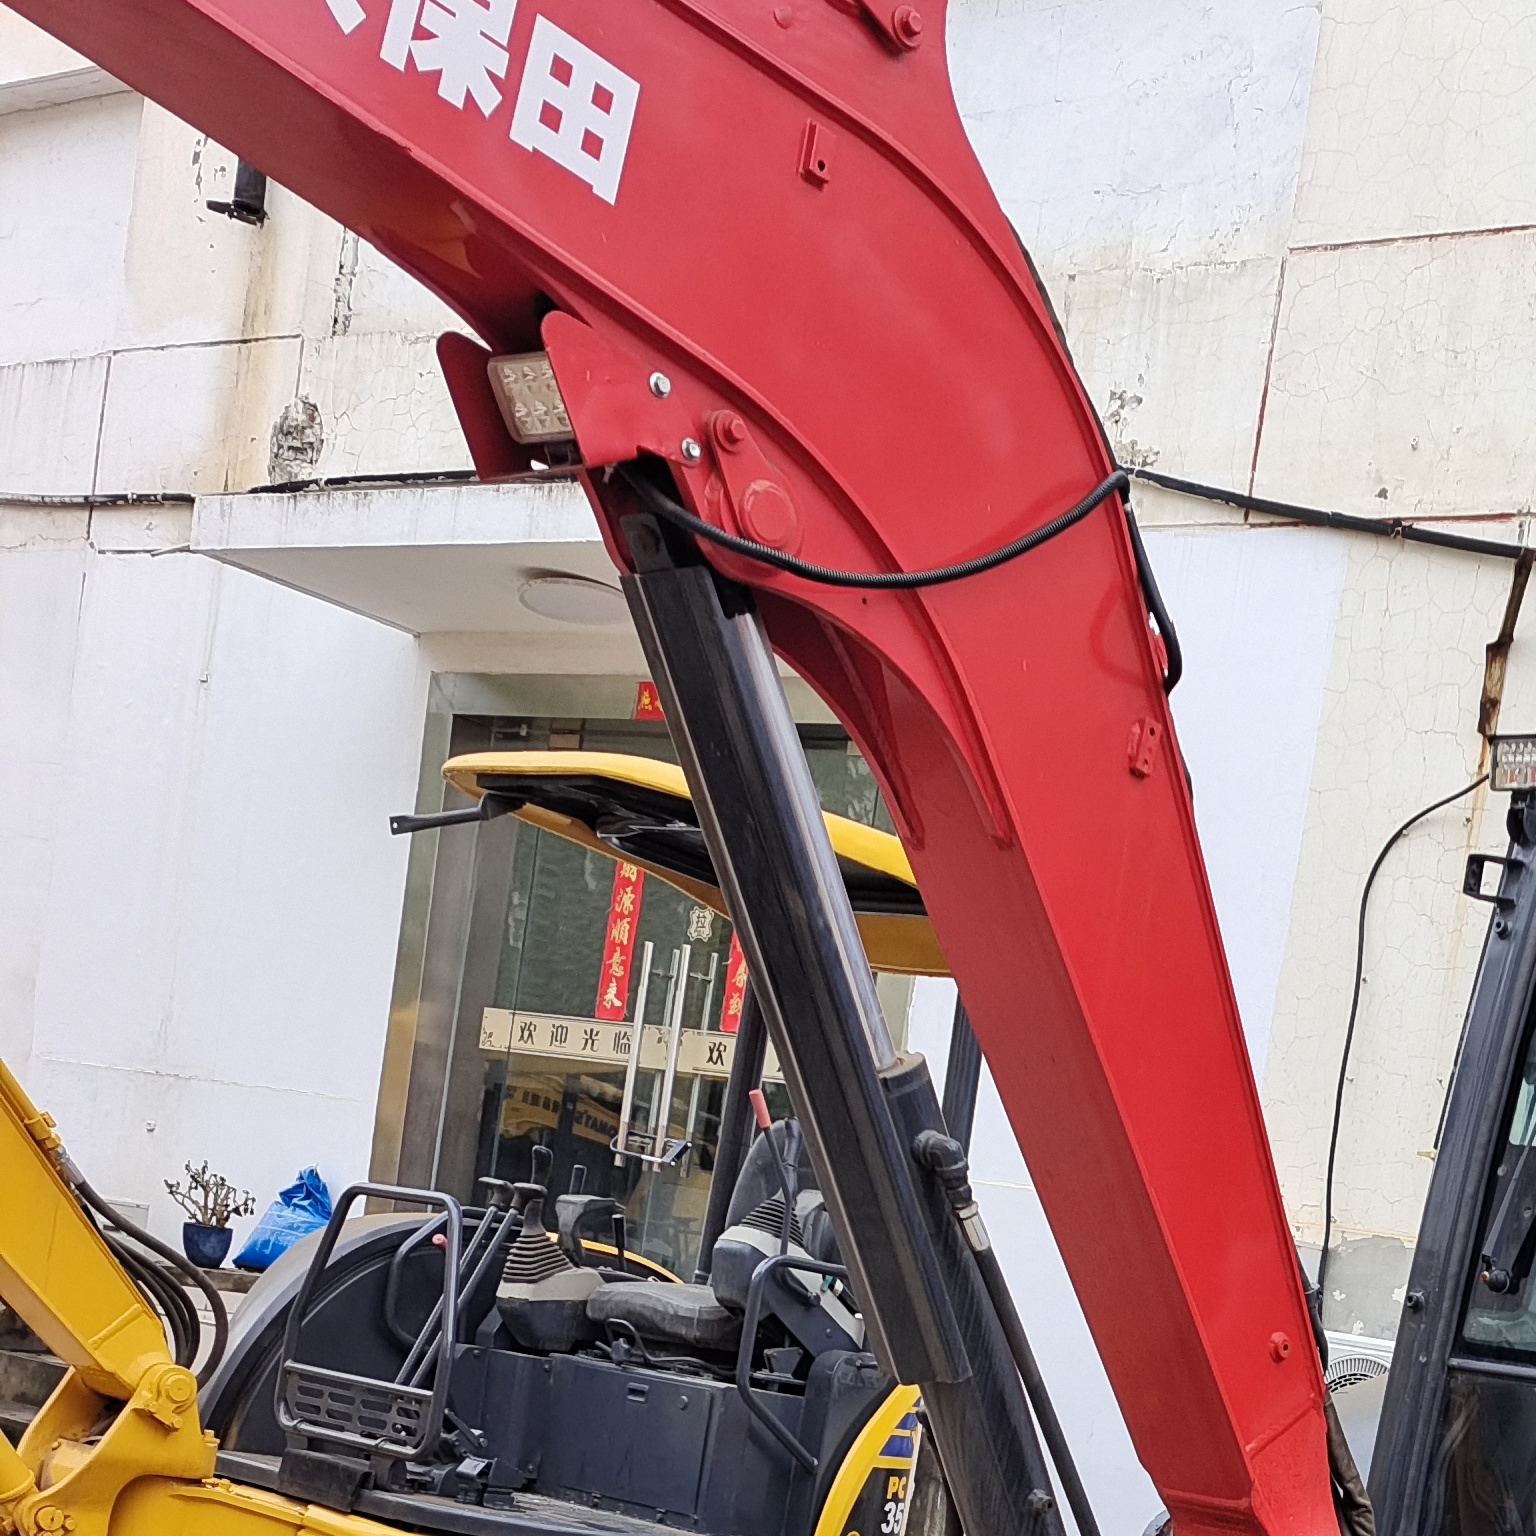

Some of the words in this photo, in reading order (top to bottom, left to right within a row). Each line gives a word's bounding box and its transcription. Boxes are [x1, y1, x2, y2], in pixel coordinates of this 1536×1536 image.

[325, 0, 641, 206] 保田
[517, 1020, 631, 1055] 欢迎光临
[880, 1501, 905, 1535] 35
